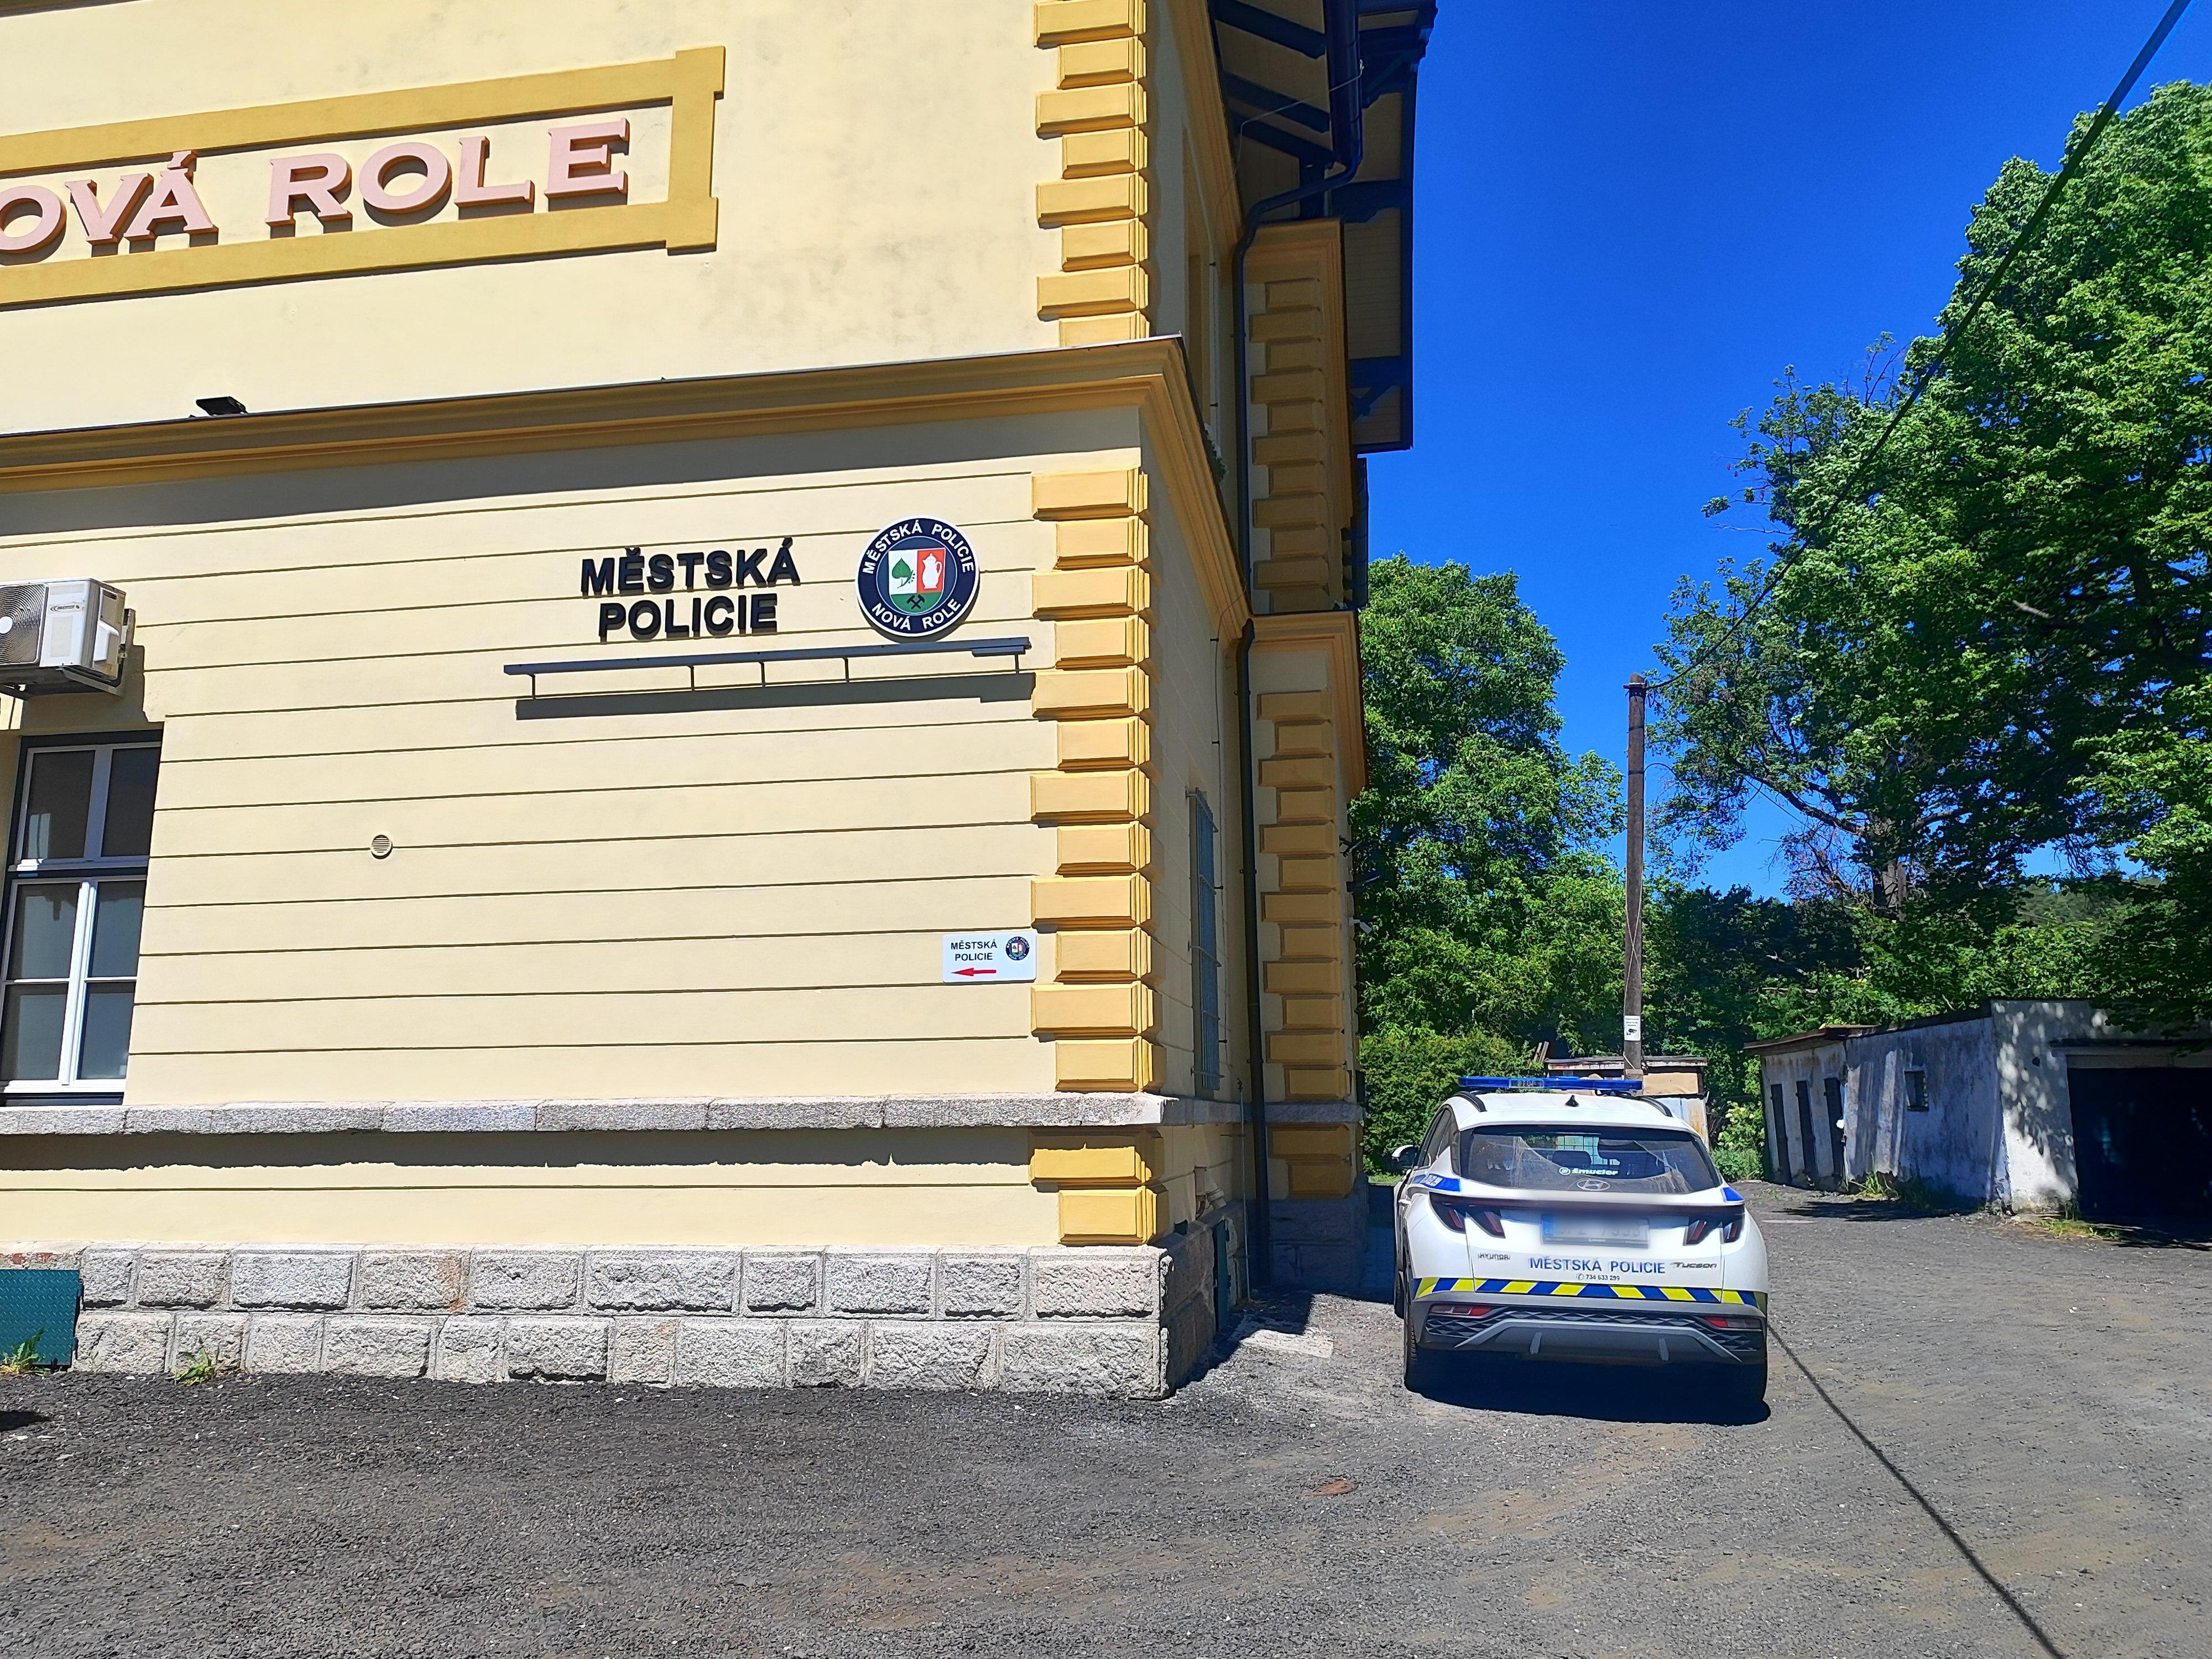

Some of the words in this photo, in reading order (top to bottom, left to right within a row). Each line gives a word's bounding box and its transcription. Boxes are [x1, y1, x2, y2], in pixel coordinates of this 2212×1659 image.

[266, 118, 629, 227] ROLE
[581, 538, 800, 595] MĚSTSKÁ
[863, 520, 922, 574] MĚSTSKÁ
[931, 523, 974, 573] POLICIE
[598, 593, 777, 640] POLICIE
[872, 602, 911, 630] NOVÁ
[922, 598, 961, 629] ROLE
[951, 939, 997, 950] MĚSTSKÁ
[955, 953, 993, 961] POLICIE
[1530, 1256, 1602, 1271] MĚSTSKÁ
[1611, 1261, 1665, 1274] POLICIE
